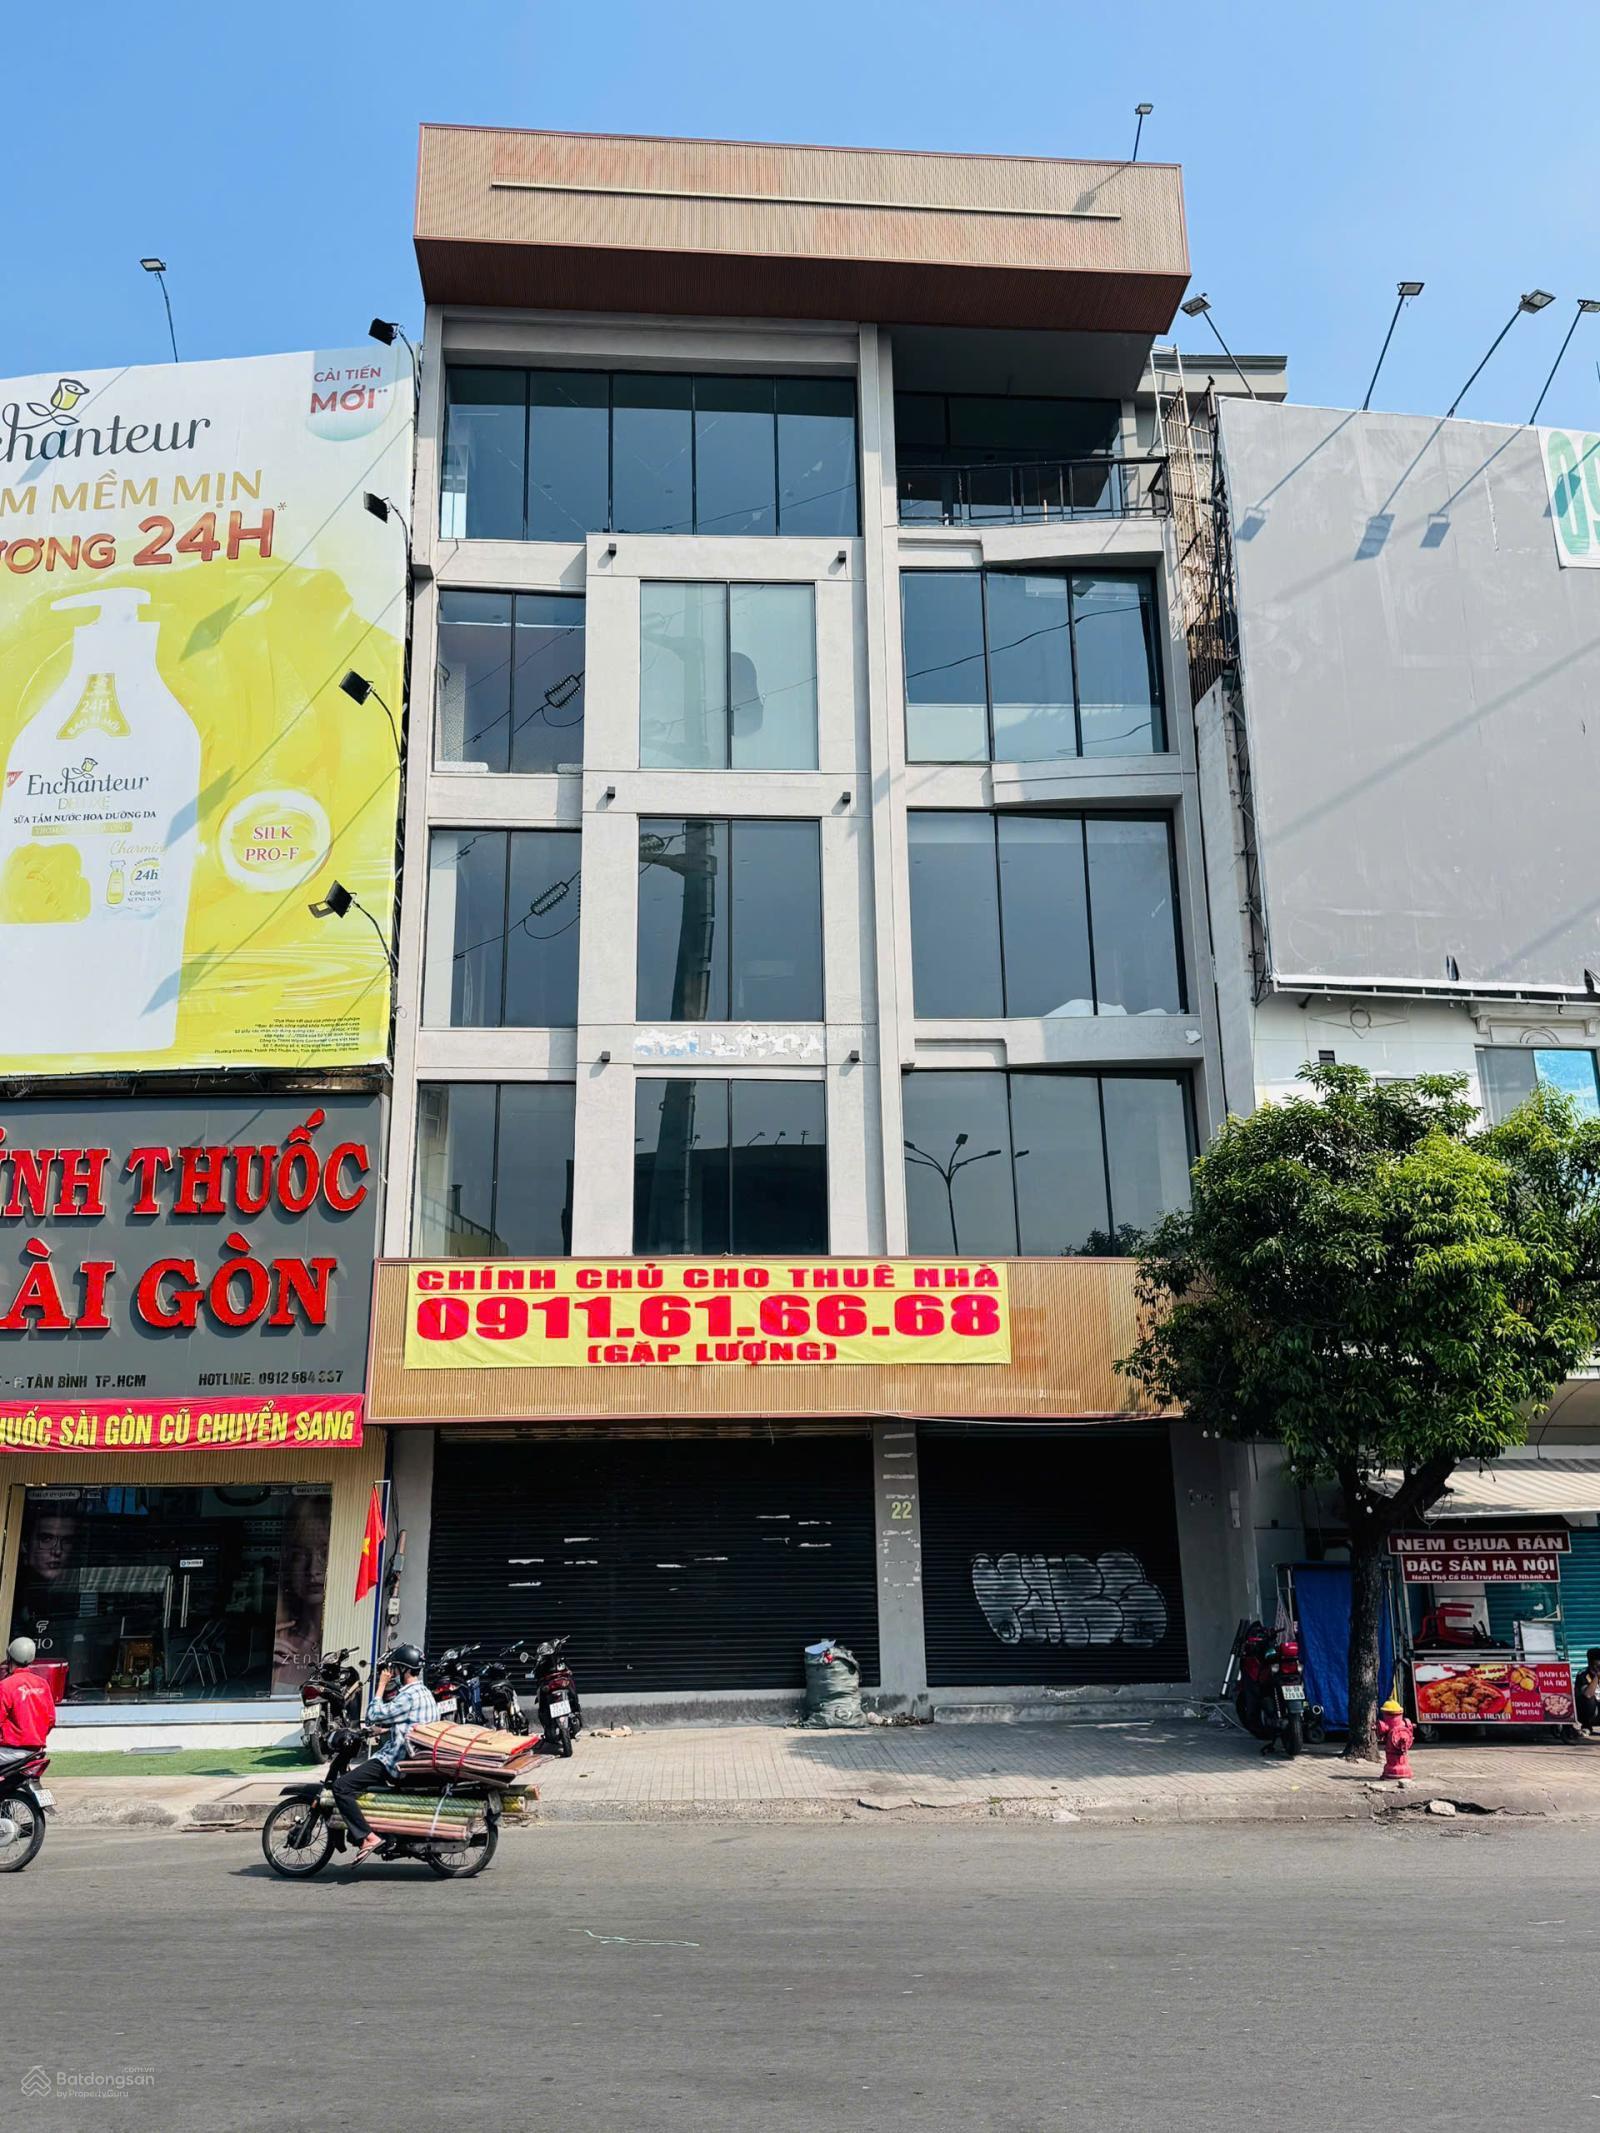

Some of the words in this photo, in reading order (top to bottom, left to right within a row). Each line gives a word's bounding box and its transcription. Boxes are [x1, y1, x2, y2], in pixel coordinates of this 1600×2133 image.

[314, 367, 341, 382] CẢI
[345, 364, 382, 380] TIẾN
[51, 469, 158, 514] MỀM
[173, 469, 262, 509] MỊN
[26, 767, 149, 796] Enchanteur
[83, 813, 103, 821] HOA
[143, 810, 157, 819] DA
[253, 826, 293, 840] SILK
[245, 847, 299, 861] PRO-F
[134, 869, 158, 881] 24h
[126, 1107, 370, 1215] THUỐC
[136, 1232, 337, 1329] GÒN
[417, 1266, 556, 1290] CHÍNH
[576, 1263, 663, 1289] CHỦ
[683, 1268, 769, 1288] CHO
[788, 1264, 895, 1288] THUÊ
[914, 1264, 999, 1288] NHÀ
[417, 1294, 1000, 1340] 0911.61.66.68
[58, 1373, 87, 1388] BÌNH
[259, 1371, 288, 1384] 0912
[60, 1410, 97, 1446] SÀI
[105, 1408, 152, 1445] GÒN
[160, 1408, 190, 1444] CŨ
[198, 1401, 287, 1443] CHUYỂN
[294, 1411, 355, 1441] SANG
[891, 1501, 913, 1519] 22
[1397, 1538, 1446, 1551] NEM
[1453, 1538, 1511, 1552] CHUA
[1517, 1535, 1563, 1550] RÁN
[1407, 1558, 1443, 1574] ĐẶC
[1449, 1556, 1487, 1572] SẢN
[1492, 1557, 1518, 1571] HÀ
[1523, 1557, 1555, 1574] NỘI
